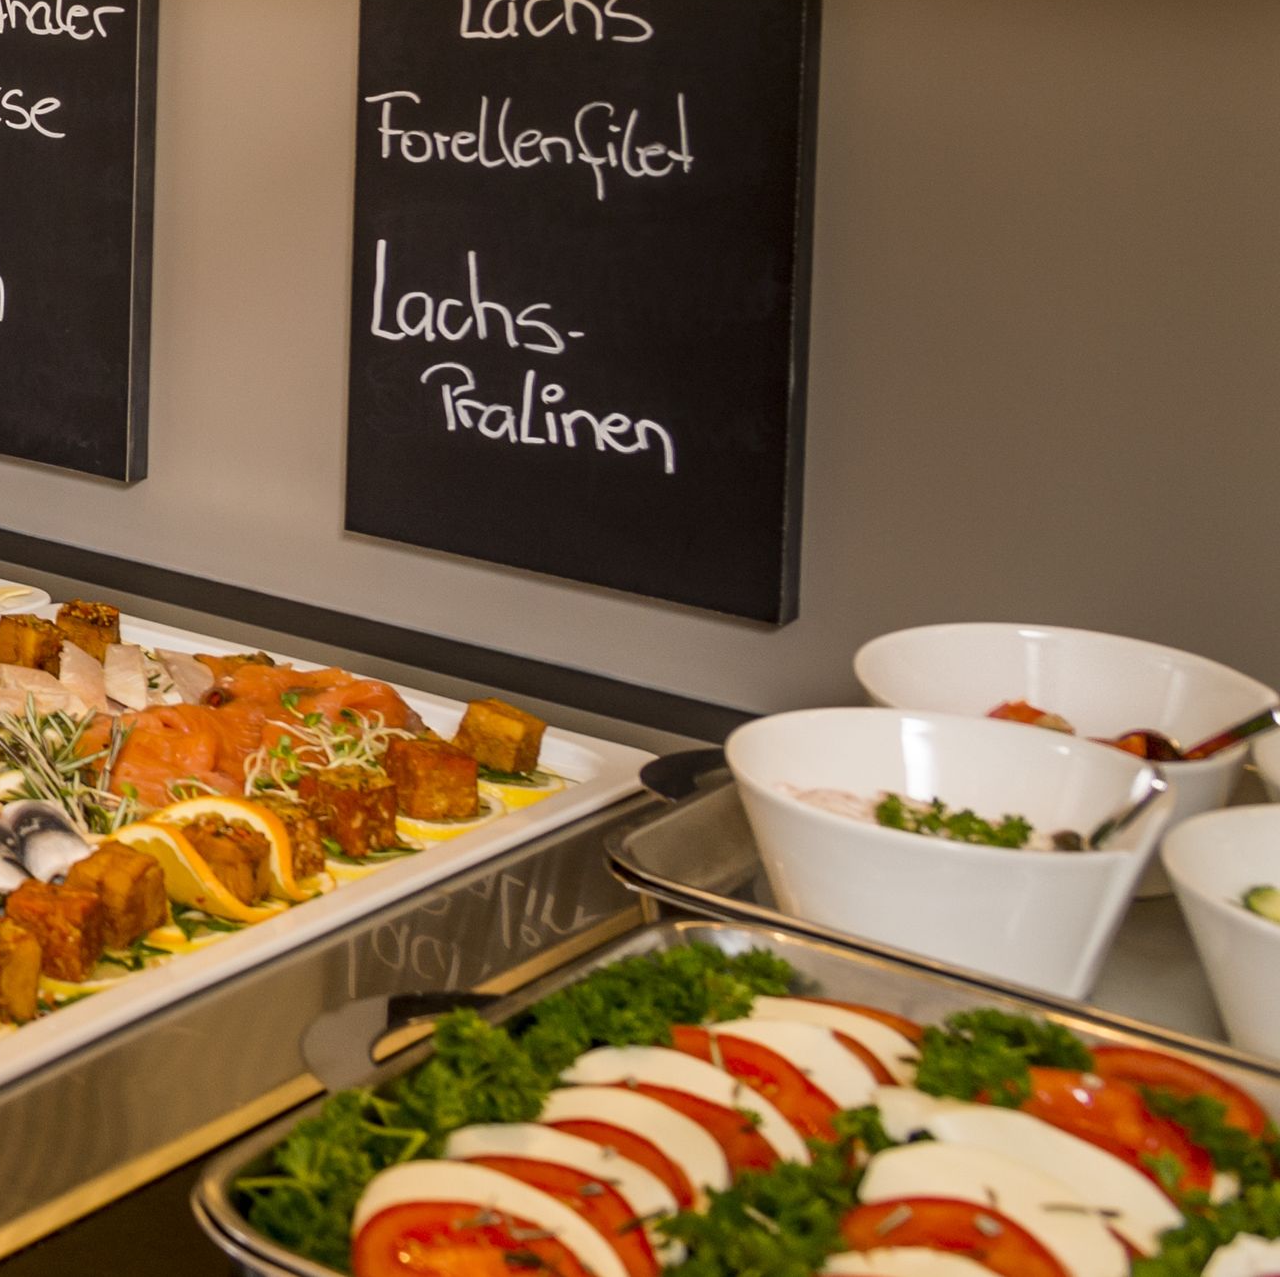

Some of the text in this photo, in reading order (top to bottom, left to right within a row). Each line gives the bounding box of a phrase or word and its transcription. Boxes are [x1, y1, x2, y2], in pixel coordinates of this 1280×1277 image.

[365, 91, 693, 200] Forellenfilet
[372, 239, 584, 355] Lachs-
[422, 362, 674, 474] Pralinen
